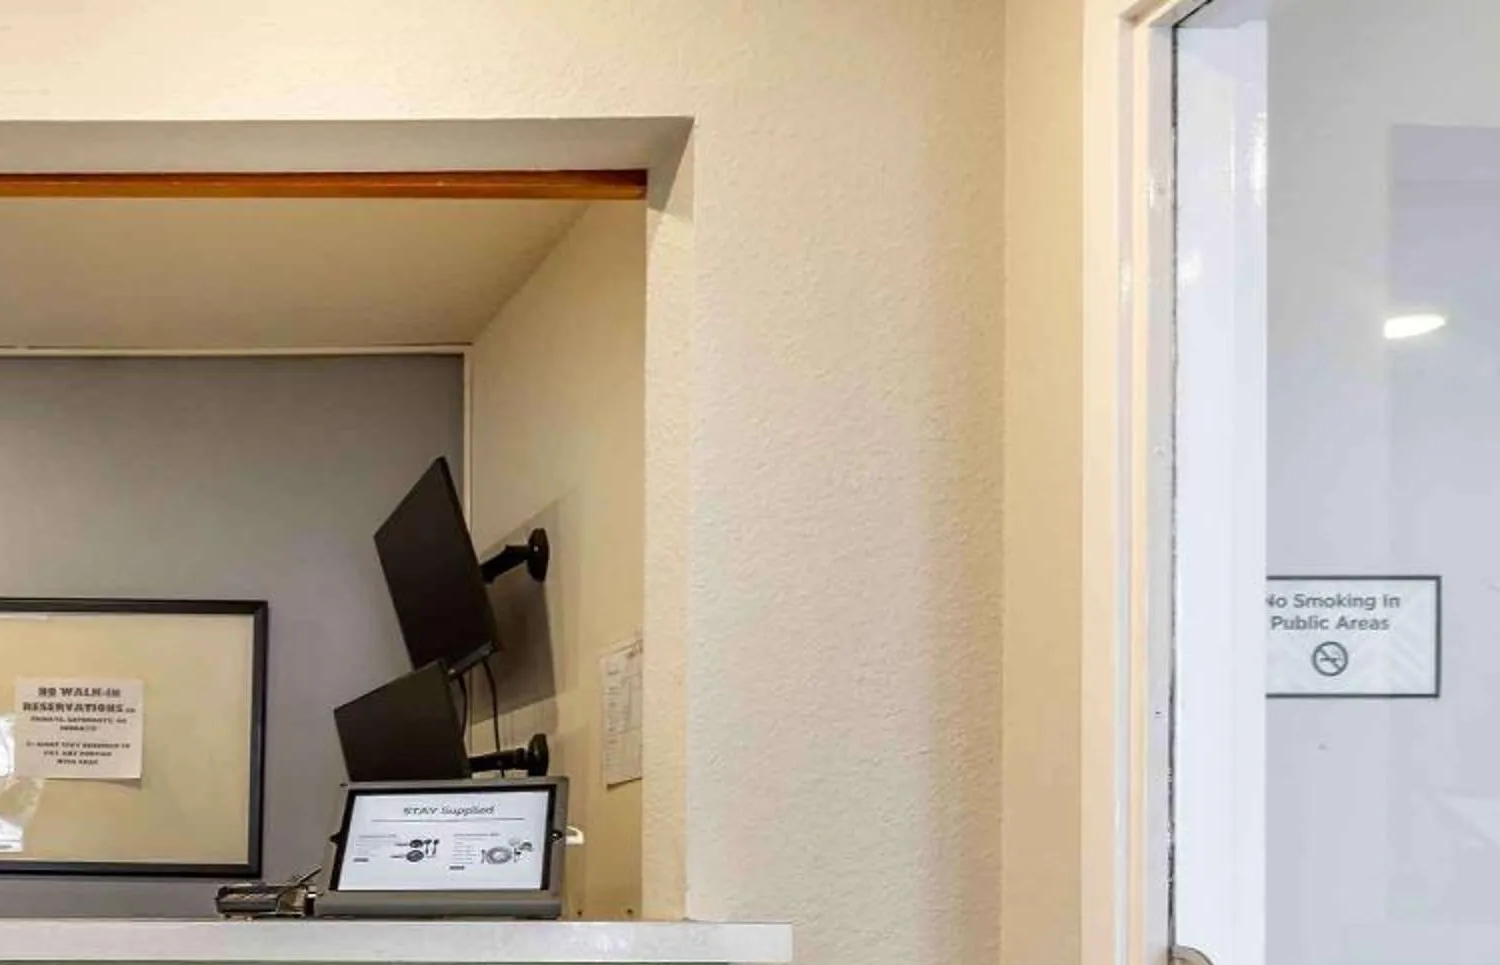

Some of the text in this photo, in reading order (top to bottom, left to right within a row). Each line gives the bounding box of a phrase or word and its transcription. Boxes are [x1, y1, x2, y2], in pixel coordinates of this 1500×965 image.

[1293, 593, 1377, 611] Smoking
[1383, 594, 1401, 609] In
[1270, 615, 1391, 631] Public Areas
[22, 702, 123, 713] RESERVATIONS
[403, 807, 438, 815] STAY
